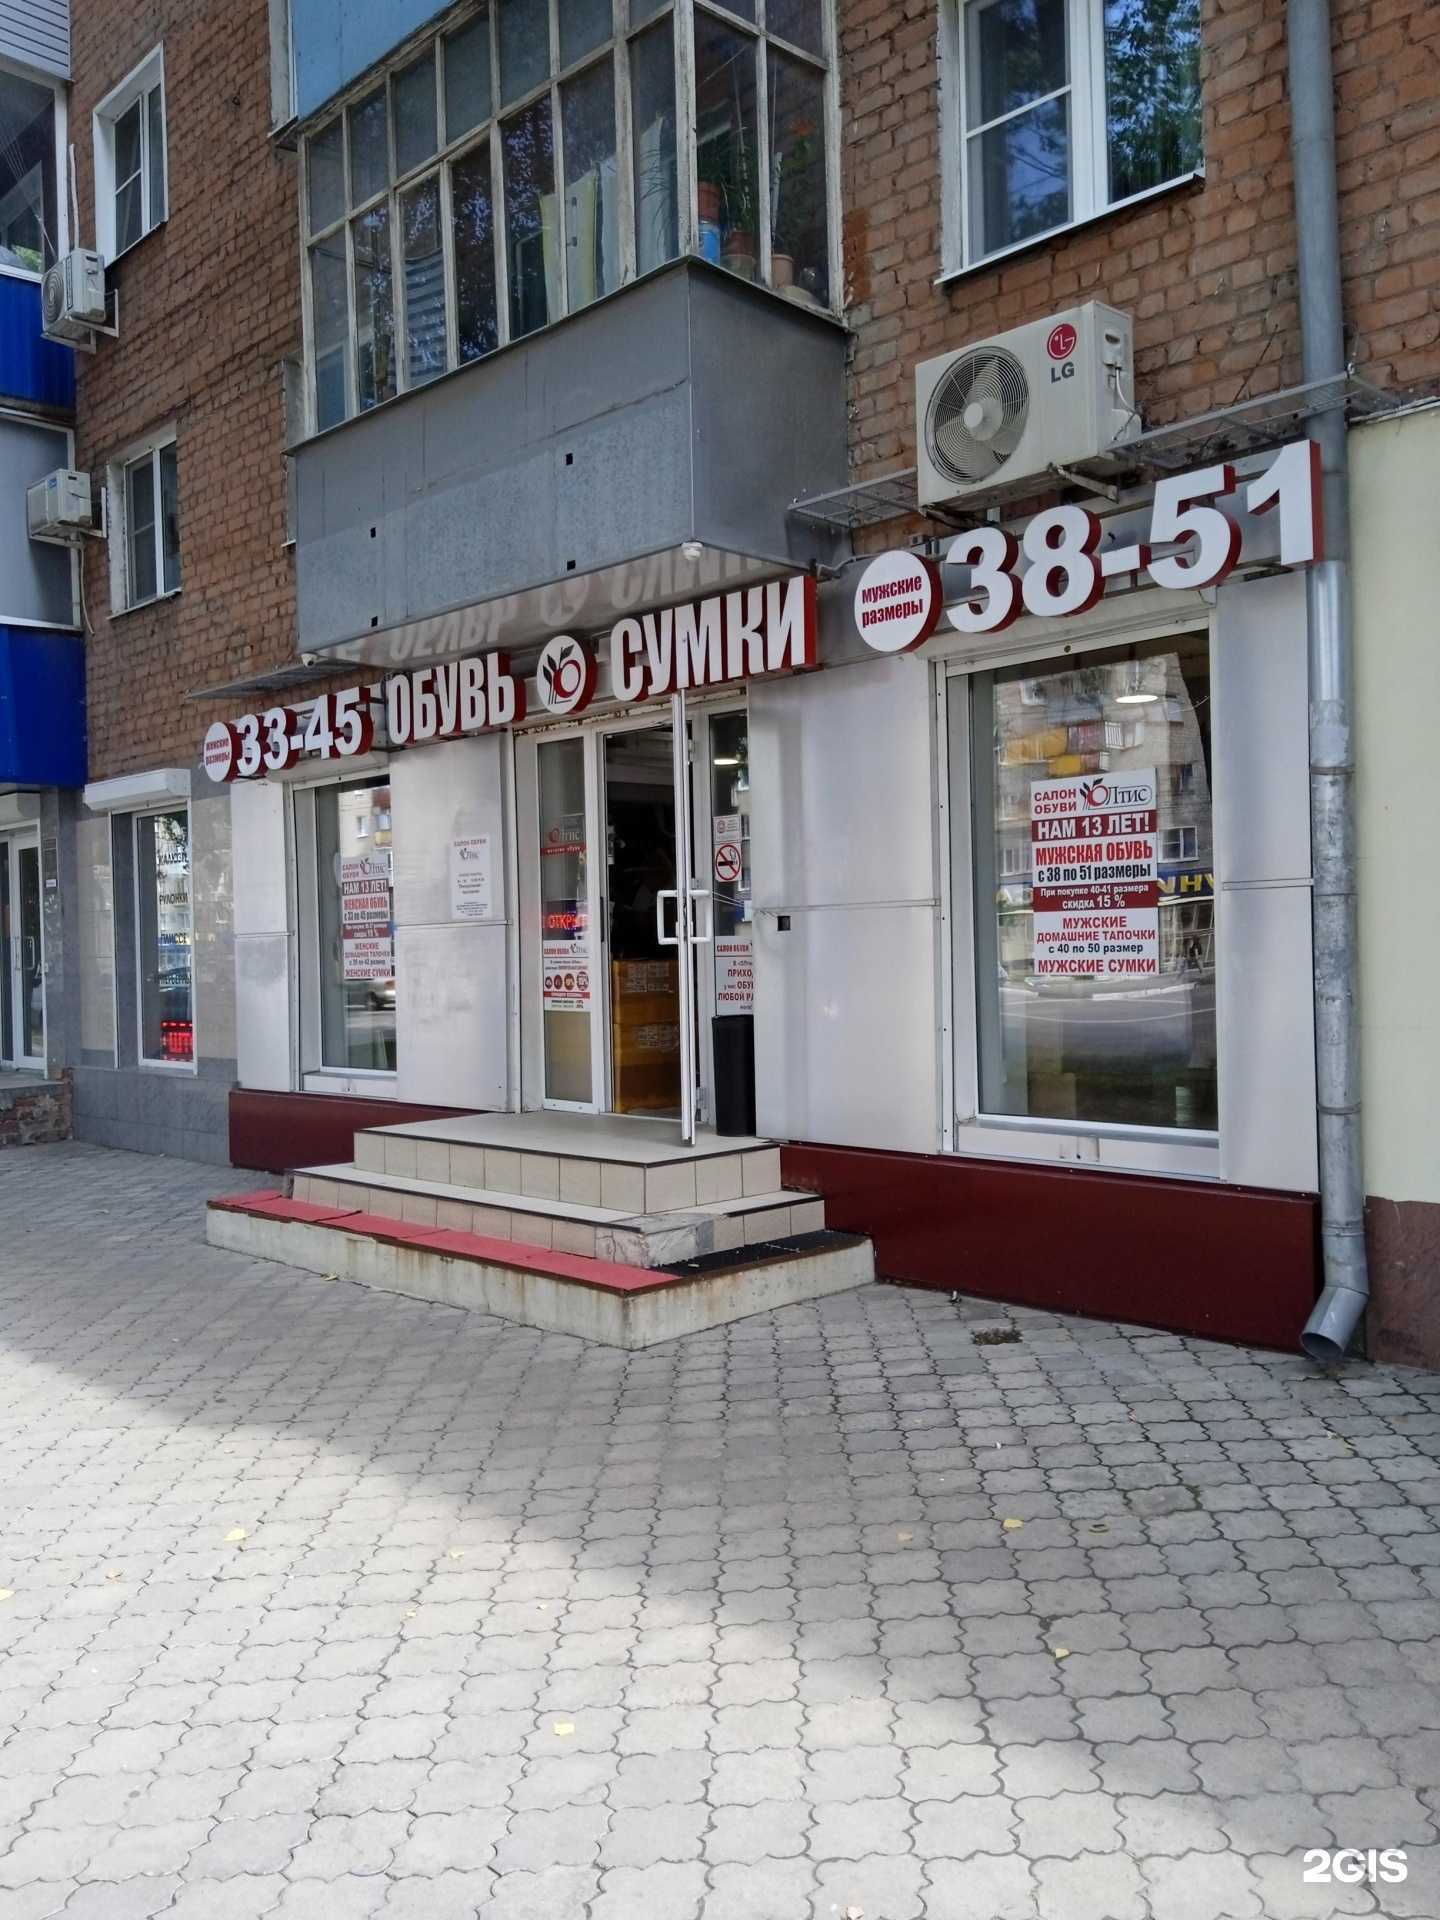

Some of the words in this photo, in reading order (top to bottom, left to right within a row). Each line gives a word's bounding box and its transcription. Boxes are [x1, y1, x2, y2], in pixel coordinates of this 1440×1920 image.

[1051, 362, 1074, 383] LG
[945, 440, 1312, 634] 38-51
[861, 574, 923, 604] мужские
[861, 598, 924, 628] размеры
[610, 576, 805, 701] СУМКИ
[388, 652, 515, 744] ОБУВЬ
[236, 687, 363, 776] 33-45
[1035, 788, 1077, 802] САЛОН
[1035, 801, 1077, 814] ОБУВИ
[1038, 818, 1075, 840] НАМ
[1082, 816, 1102, 836] 13
[1107, 813, 1150, 833] ЛЕТ!
[1036, 843, 1102, 866] МУЖСКАЯ
[1107, 840, 1153, 860] ОБУВЬ
[1047, 866, 1061, 882] 38
[1064, 869, 1077, 881] по
[1079, 865, 1093, 880] 51
[1095, 864, 1151, 882] размеры
[344, 882, 359, 894] НАМ
[1041, 888, 1055, 897] При
[1057, 887, 1088, 897] покупке
[1090, 885, 1111, 894] 40-41
[1114, 884, 1148, 894] размера
[1097, 896, 1111, 908] 15
[1115, 895, 1125, 907] %
[1063, 916, 1127, 929] МУЖСКИЕ
[1037, 932, 1099, 944] ДОМАШНИЕ
[1104, 930, 1156, 940] ТАПОЧКИ
[1057, 944, 1069, 953] 40
[1088, 943, 1100, 953] 50
[1104, 944, 1143, 955] размер
[346, 968, 371, 977] ЖЕНСКИЕ
[1038, 960, 1104, 973] МУЖСКИЕ
[1108, 959, 1156, 972] СУМКИ
